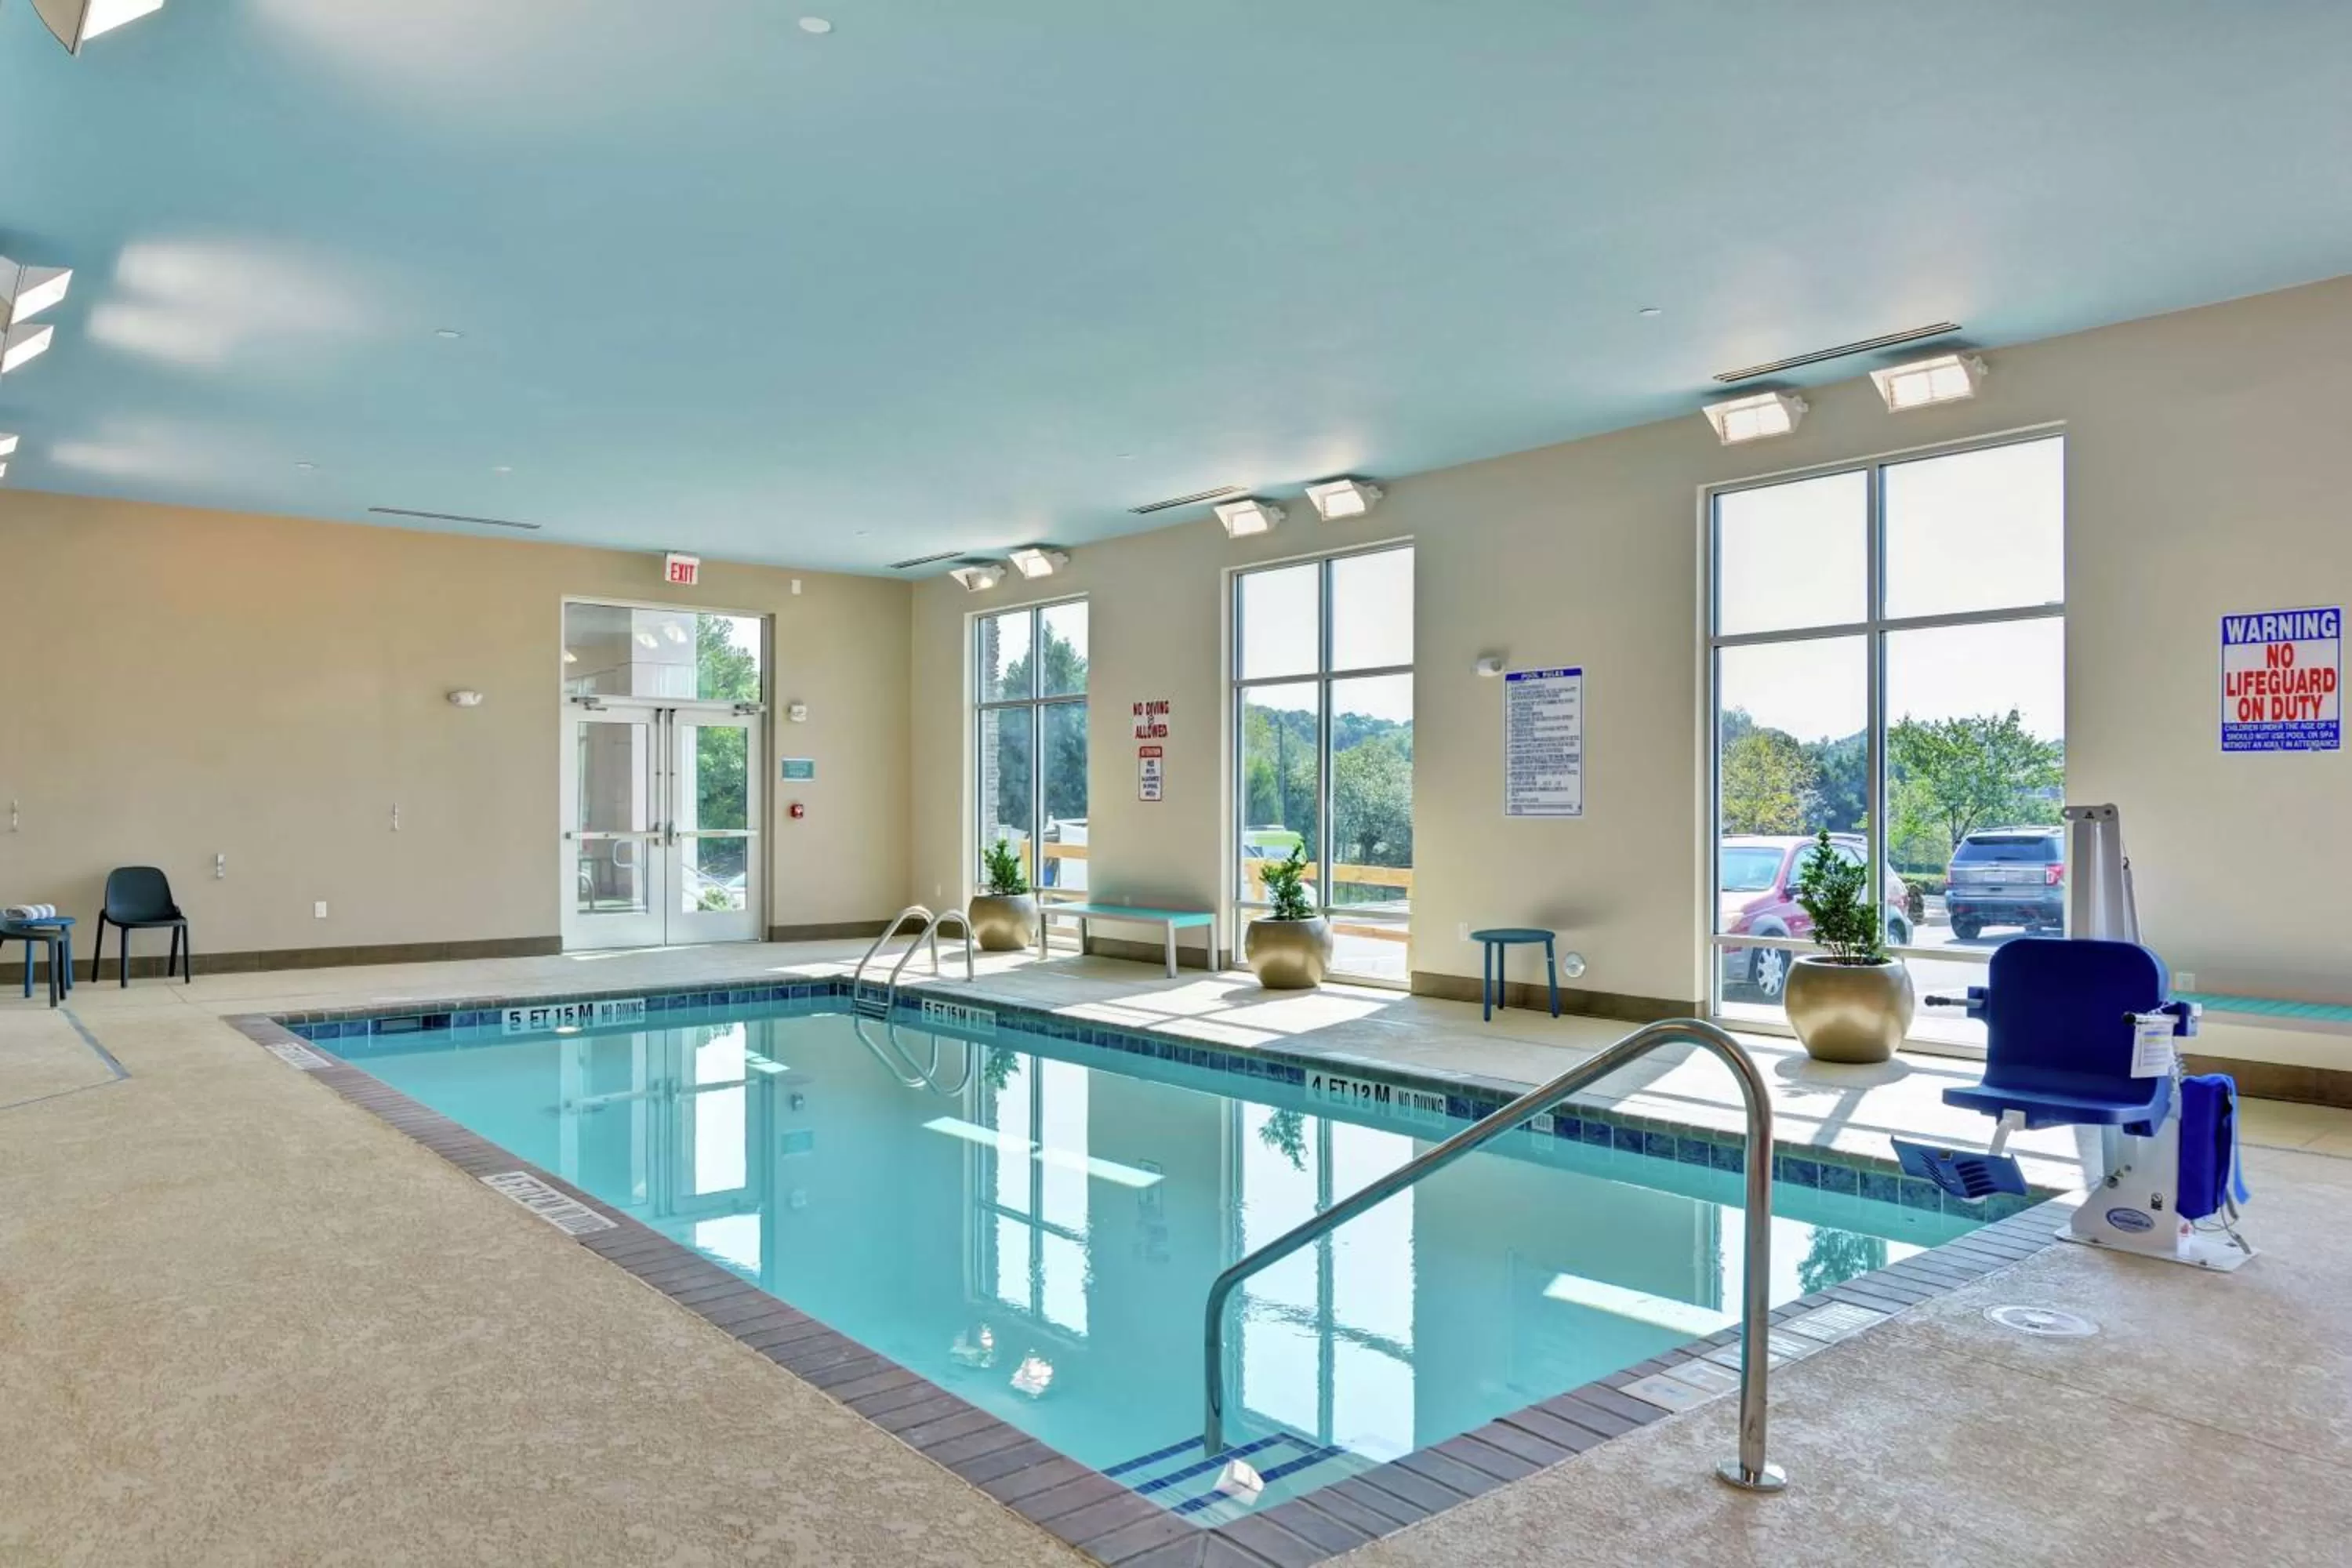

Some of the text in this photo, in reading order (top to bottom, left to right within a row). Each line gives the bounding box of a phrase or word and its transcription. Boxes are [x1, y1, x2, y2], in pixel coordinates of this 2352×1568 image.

[670, 562, 695, 583] EXIT
[2226, 611, 2337, 643] WARNING
[2267, 643, 2294, 668] NO
[2226, 668, 2336, 696] LIFEGUARD
[1133, 701, 1169, 716] NO DIVING
[2238, 695, 2323, 722] ON DUTY
[1134, 724, 1168, 739] ALLOWED
[2294, 739, 2338, 748] ATTENDANCE
[510, 1011, 521, 1028] 5
[1398, 1091, 1410, 1110] NO
[1414, 1094, 1443, 1118] DIVING
